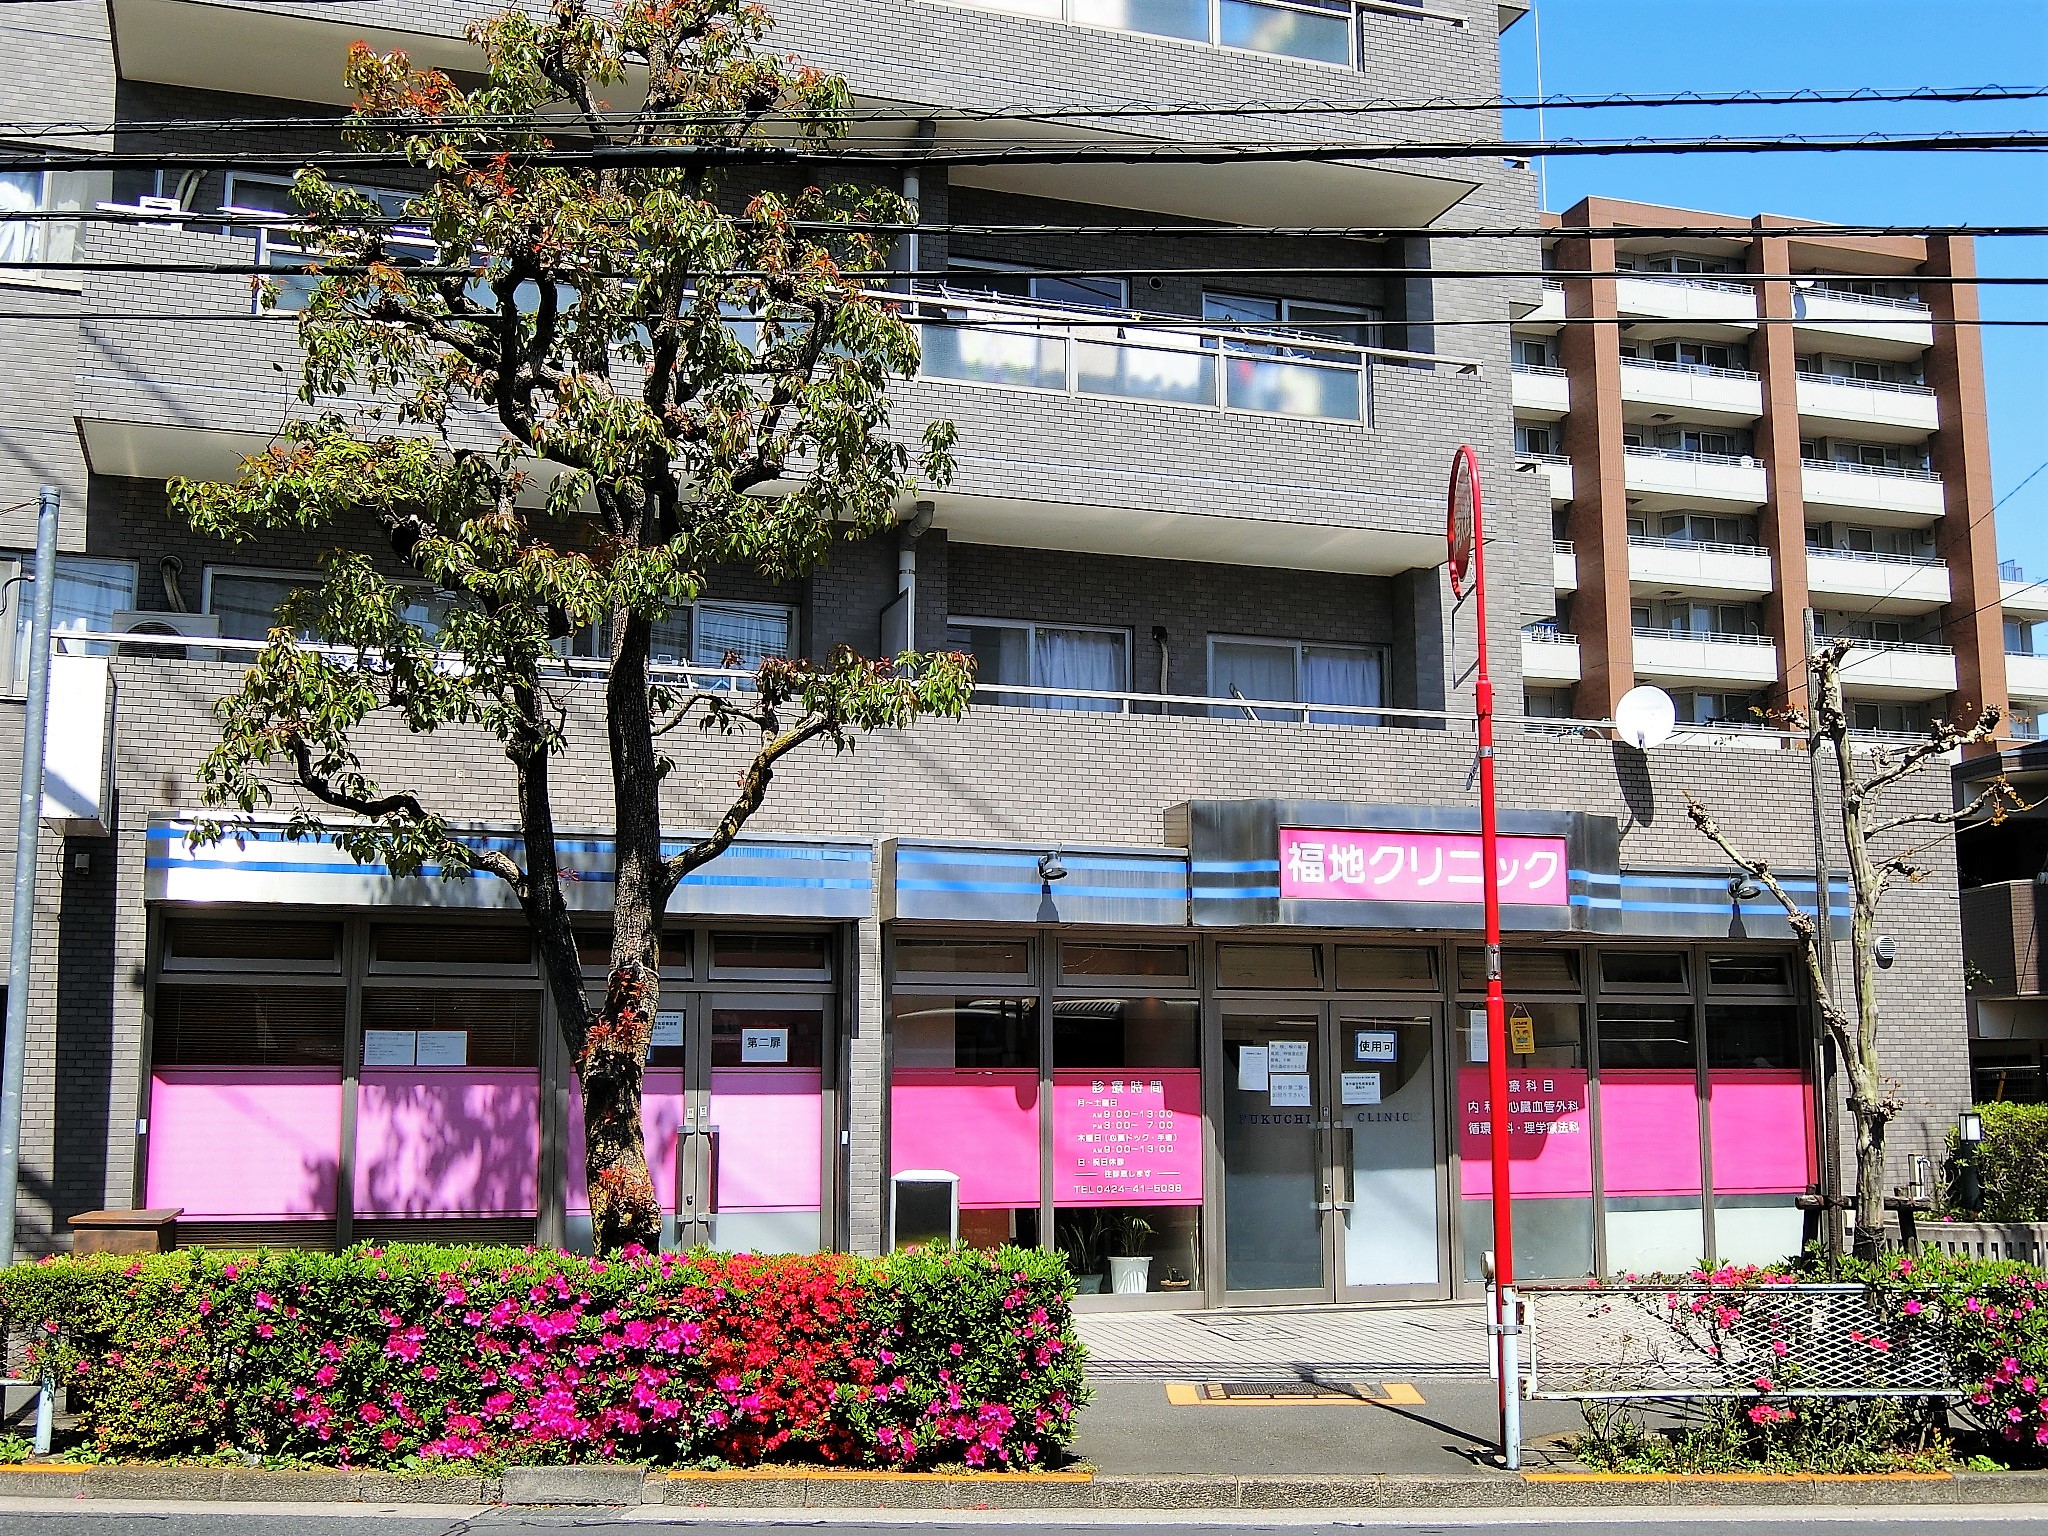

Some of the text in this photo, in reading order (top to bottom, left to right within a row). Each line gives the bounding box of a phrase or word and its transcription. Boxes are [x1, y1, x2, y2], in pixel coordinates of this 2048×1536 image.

[1288, 841, 1558, 889] 福地クリニック
[747, 1036, 781, 1049] 第二扉
[1359, 1040, 1394, 1053] 使用可
[1091, 1080, 1163, 1094] 診療時間
[1357, 1112, 1410, 1122] CLINIC
